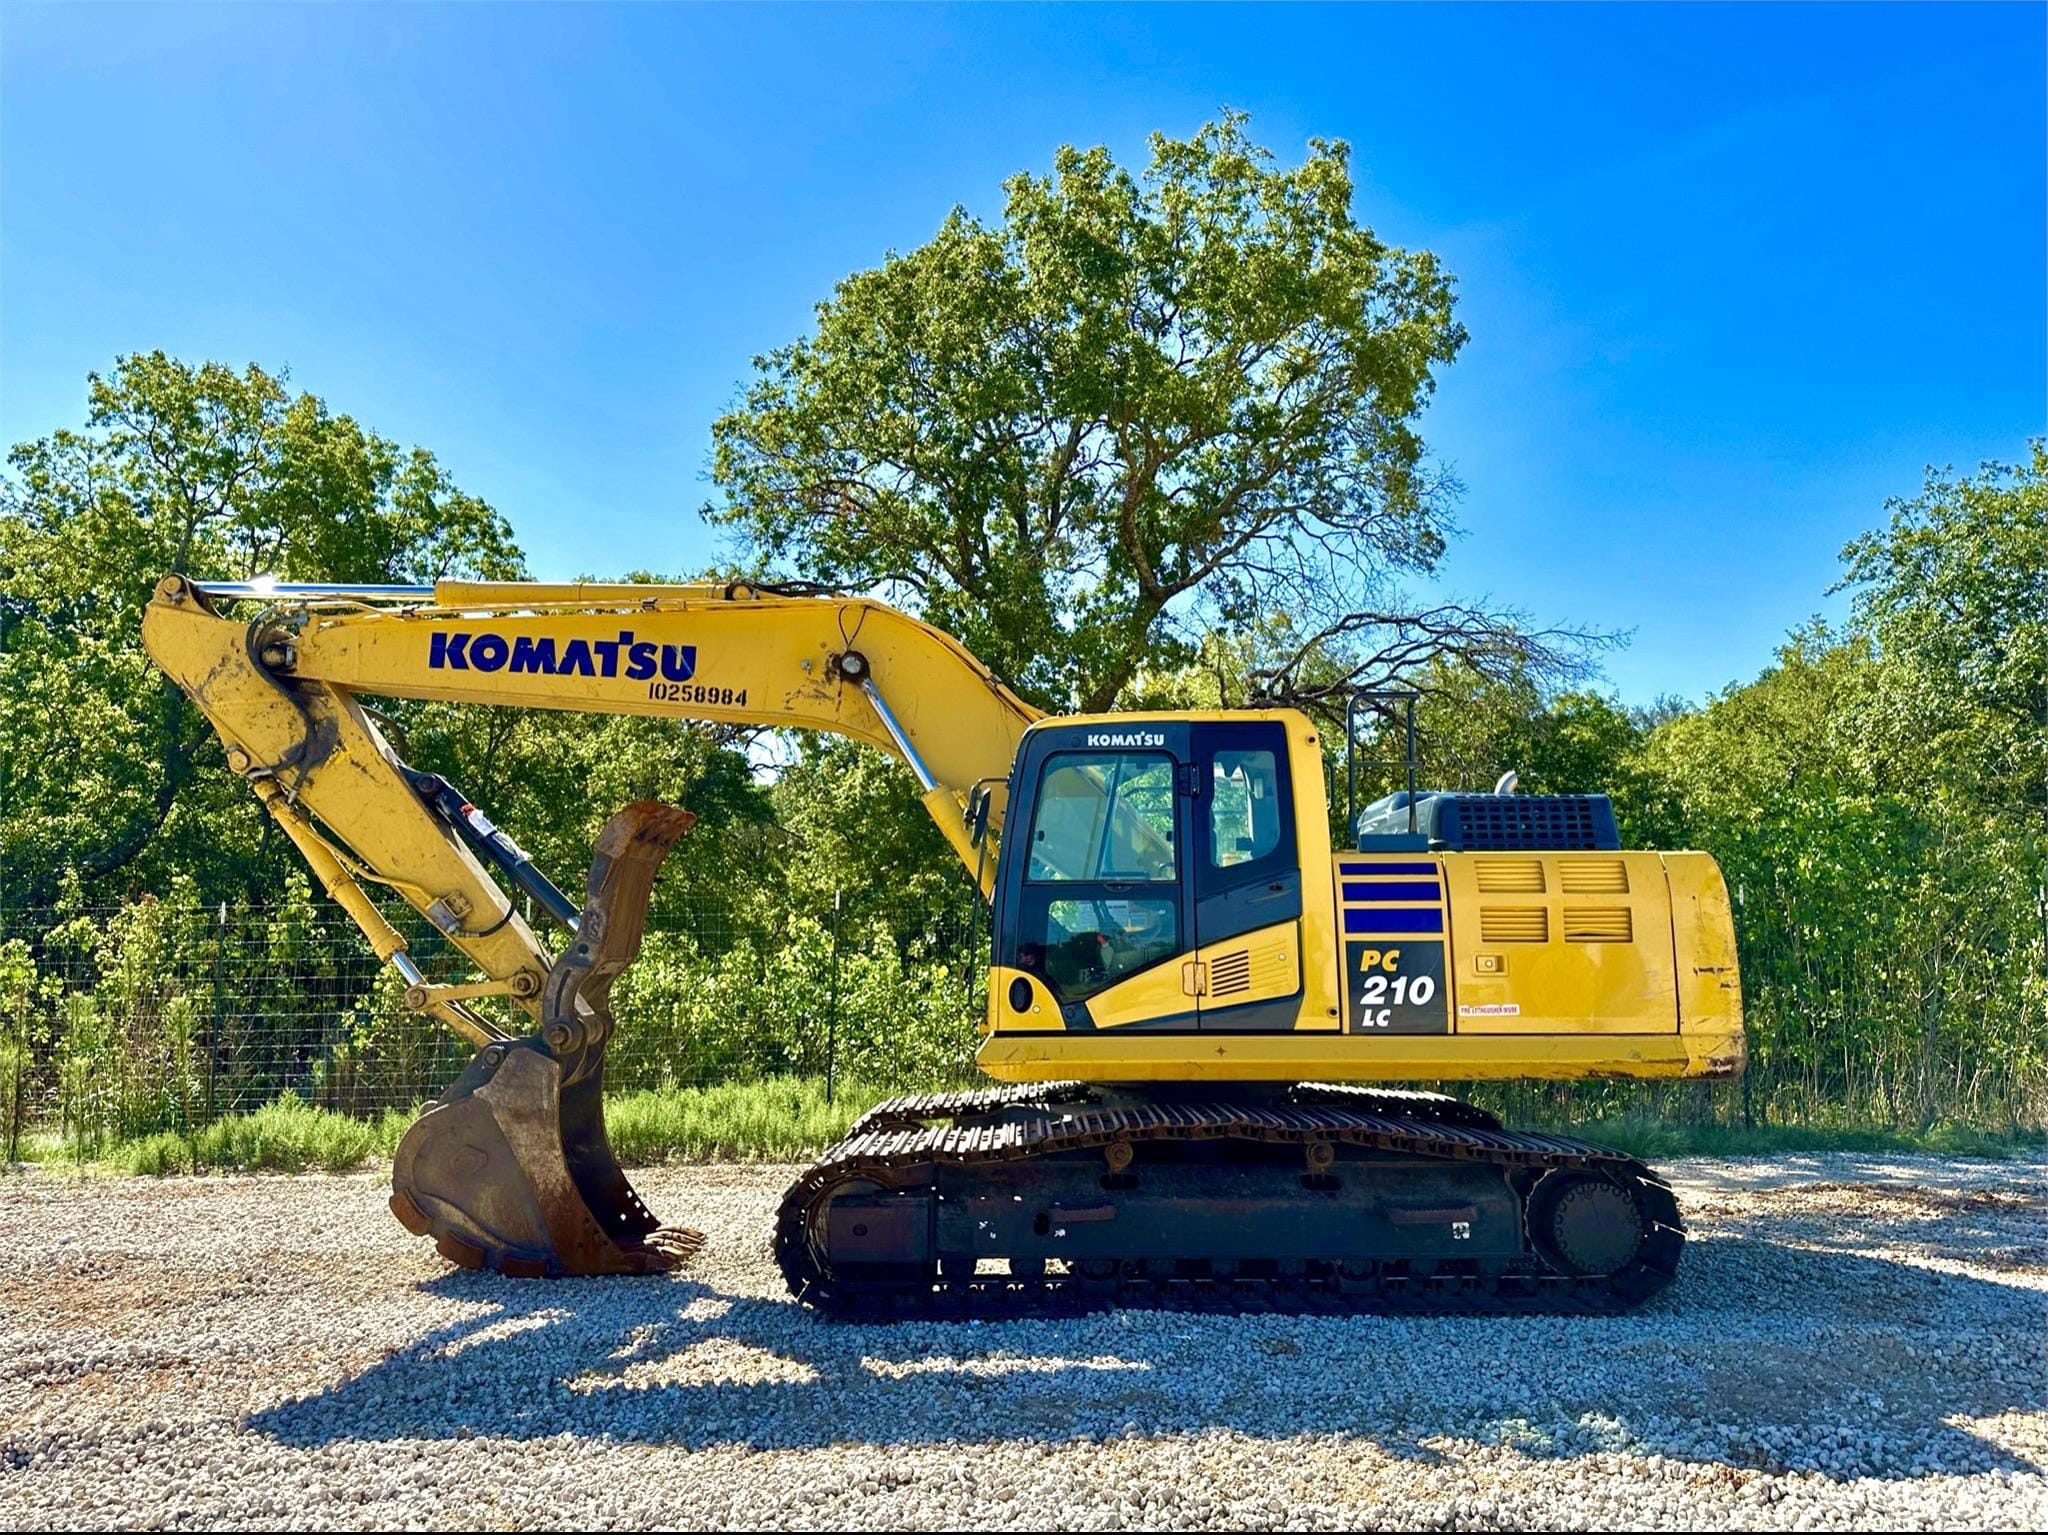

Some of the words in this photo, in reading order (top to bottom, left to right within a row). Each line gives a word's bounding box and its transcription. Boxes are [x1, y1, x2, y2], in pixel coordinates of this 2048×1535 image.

[429, 631, 697, 682] KOMATSU
[649, 682, 747, 707] 10258984
[1087, 731, 1165, 747] KOMATSU
[1360, 949, 1400, 972] PC
[1360, 975, 1435, 1006] 210
[1361, 1008, 1392, 1027] LC
